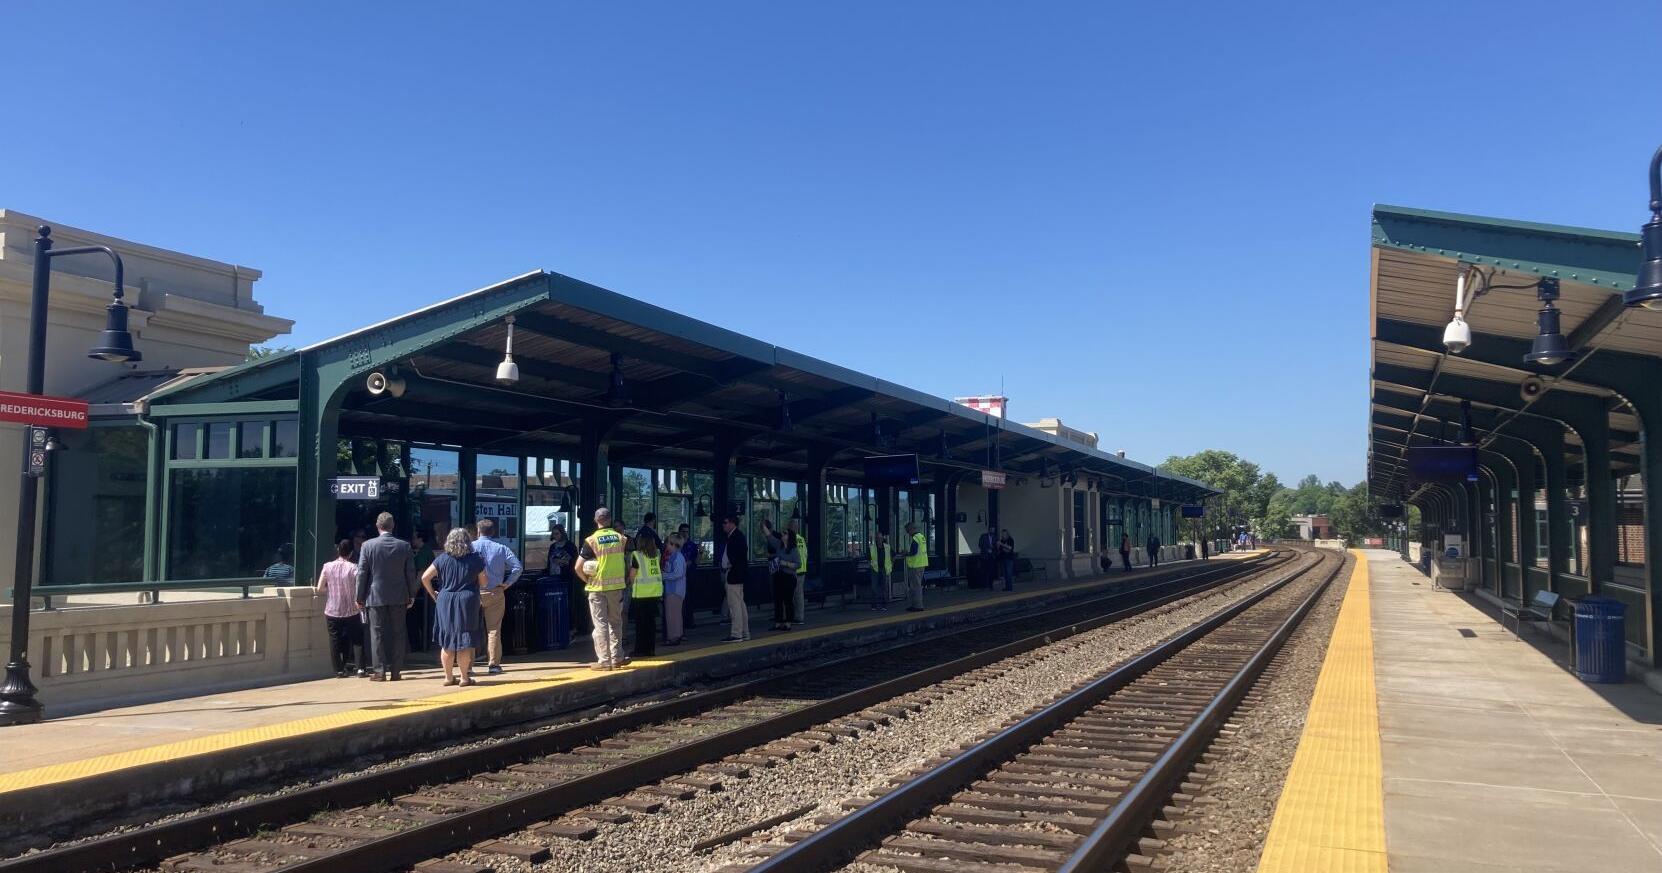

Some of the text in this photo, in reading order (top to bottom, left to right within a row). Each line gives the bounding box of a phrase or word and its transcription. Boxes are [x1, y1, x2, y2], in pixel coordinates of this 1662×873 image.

[0, 404, 85, 419] REDERICKSBURG
[340, 483, 366, 494] EXIT
[474, 503, 517, 516] ston Hall
[1571, 505, 1580, 516] 3
[598, 534, 619, 543] CLARK
